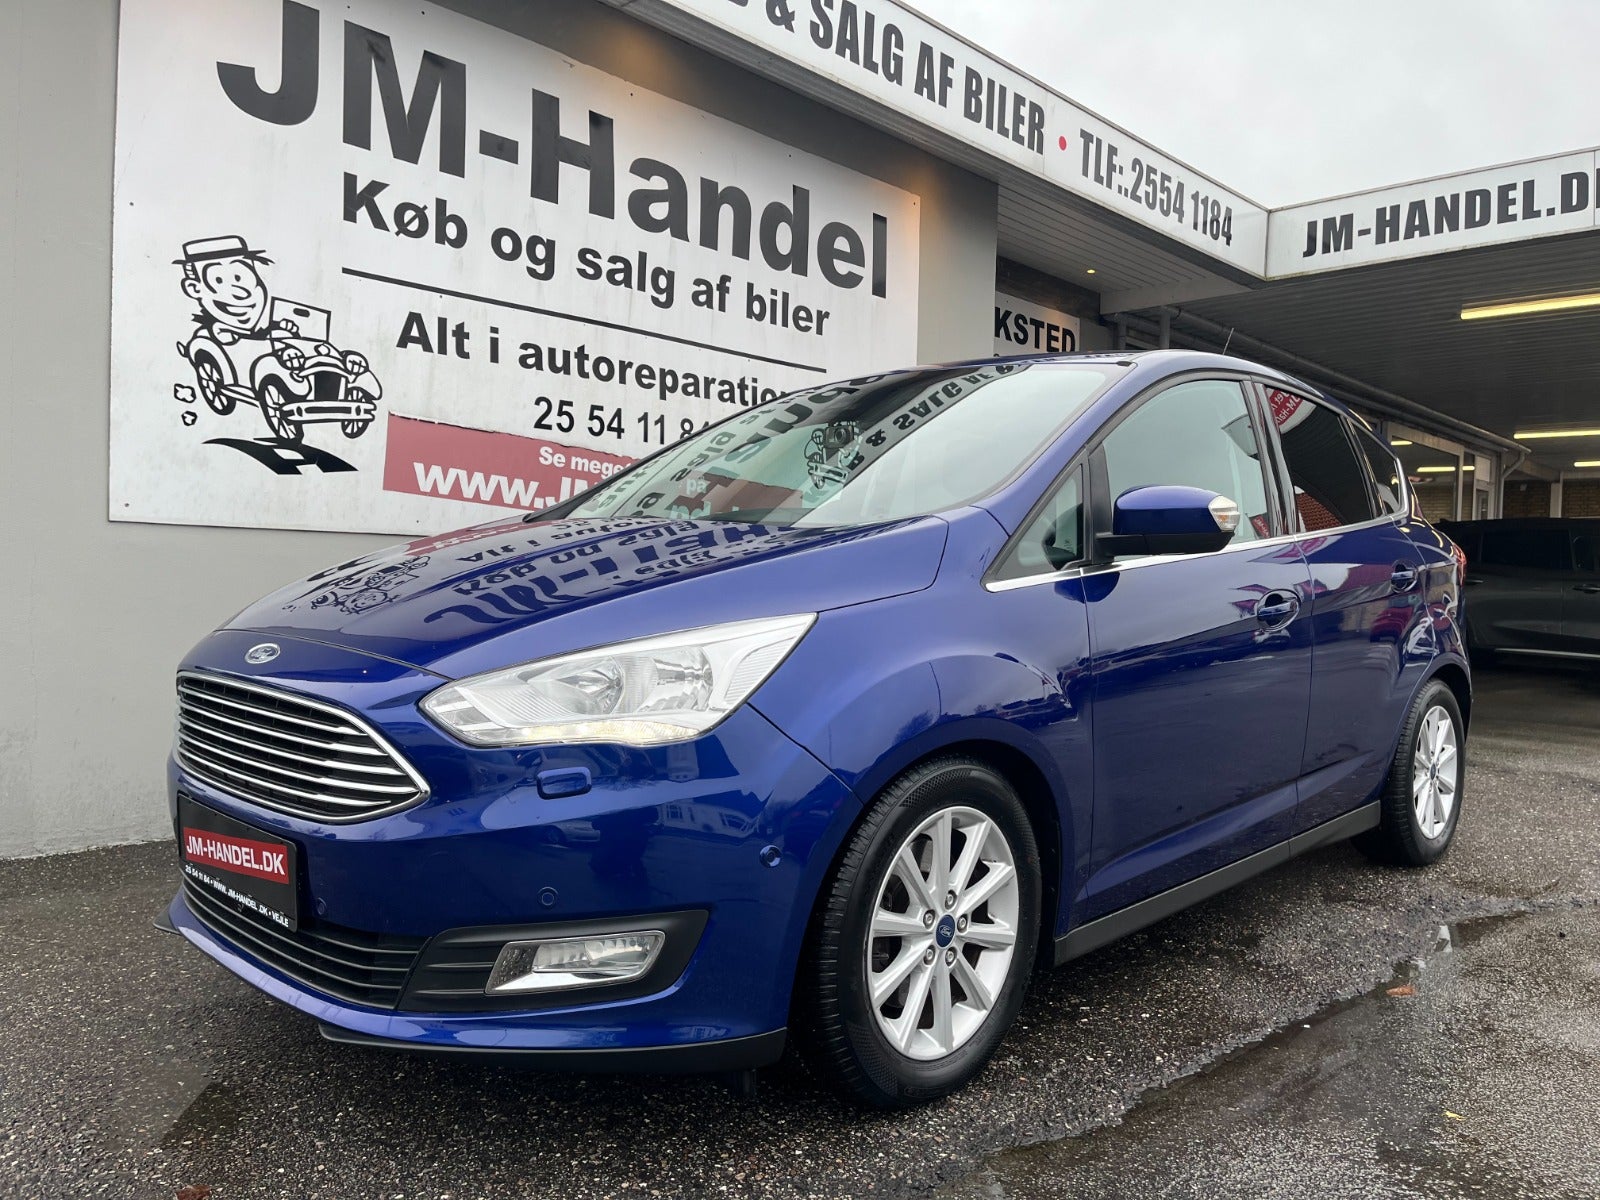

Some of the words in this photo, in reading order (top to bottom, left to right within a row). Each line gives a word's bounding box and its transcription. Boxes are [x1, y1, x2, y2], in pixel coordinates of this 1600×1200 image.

[809, 0, 904, 87] SALG
[914, 41, 955, 109] AF
[964, 65, 1045, 155] BILER
[1190, 190, 1233, 248] 1184
[216, 0, 888, 299] JM-Handel
[343, 171, 468, 249] Køb
[491, 227, 556, 281] og
[576, 247, 676, 310] salg
[691, 274, 732, 313] af
[746, 281, 830, 336] biler
[994, 306, 1076, 353] KSTED
[396, 311, 470, 360] Alt
[489, 326, 500, 364] i
[518, 340, 787, 407] autoreparatio
[534, 396, 575, 433] 25
[587, 405, 625, 440] 54
[637, 412, 665, 445] 11
[680, 417, 710, 440] 8
[539, 446, 566, 468] Se
[570, 456, 631, 480] mege
[186, 835, 286, 876] JM-HANDEL.DK
[272, 910, 289, 928] VEJLE
